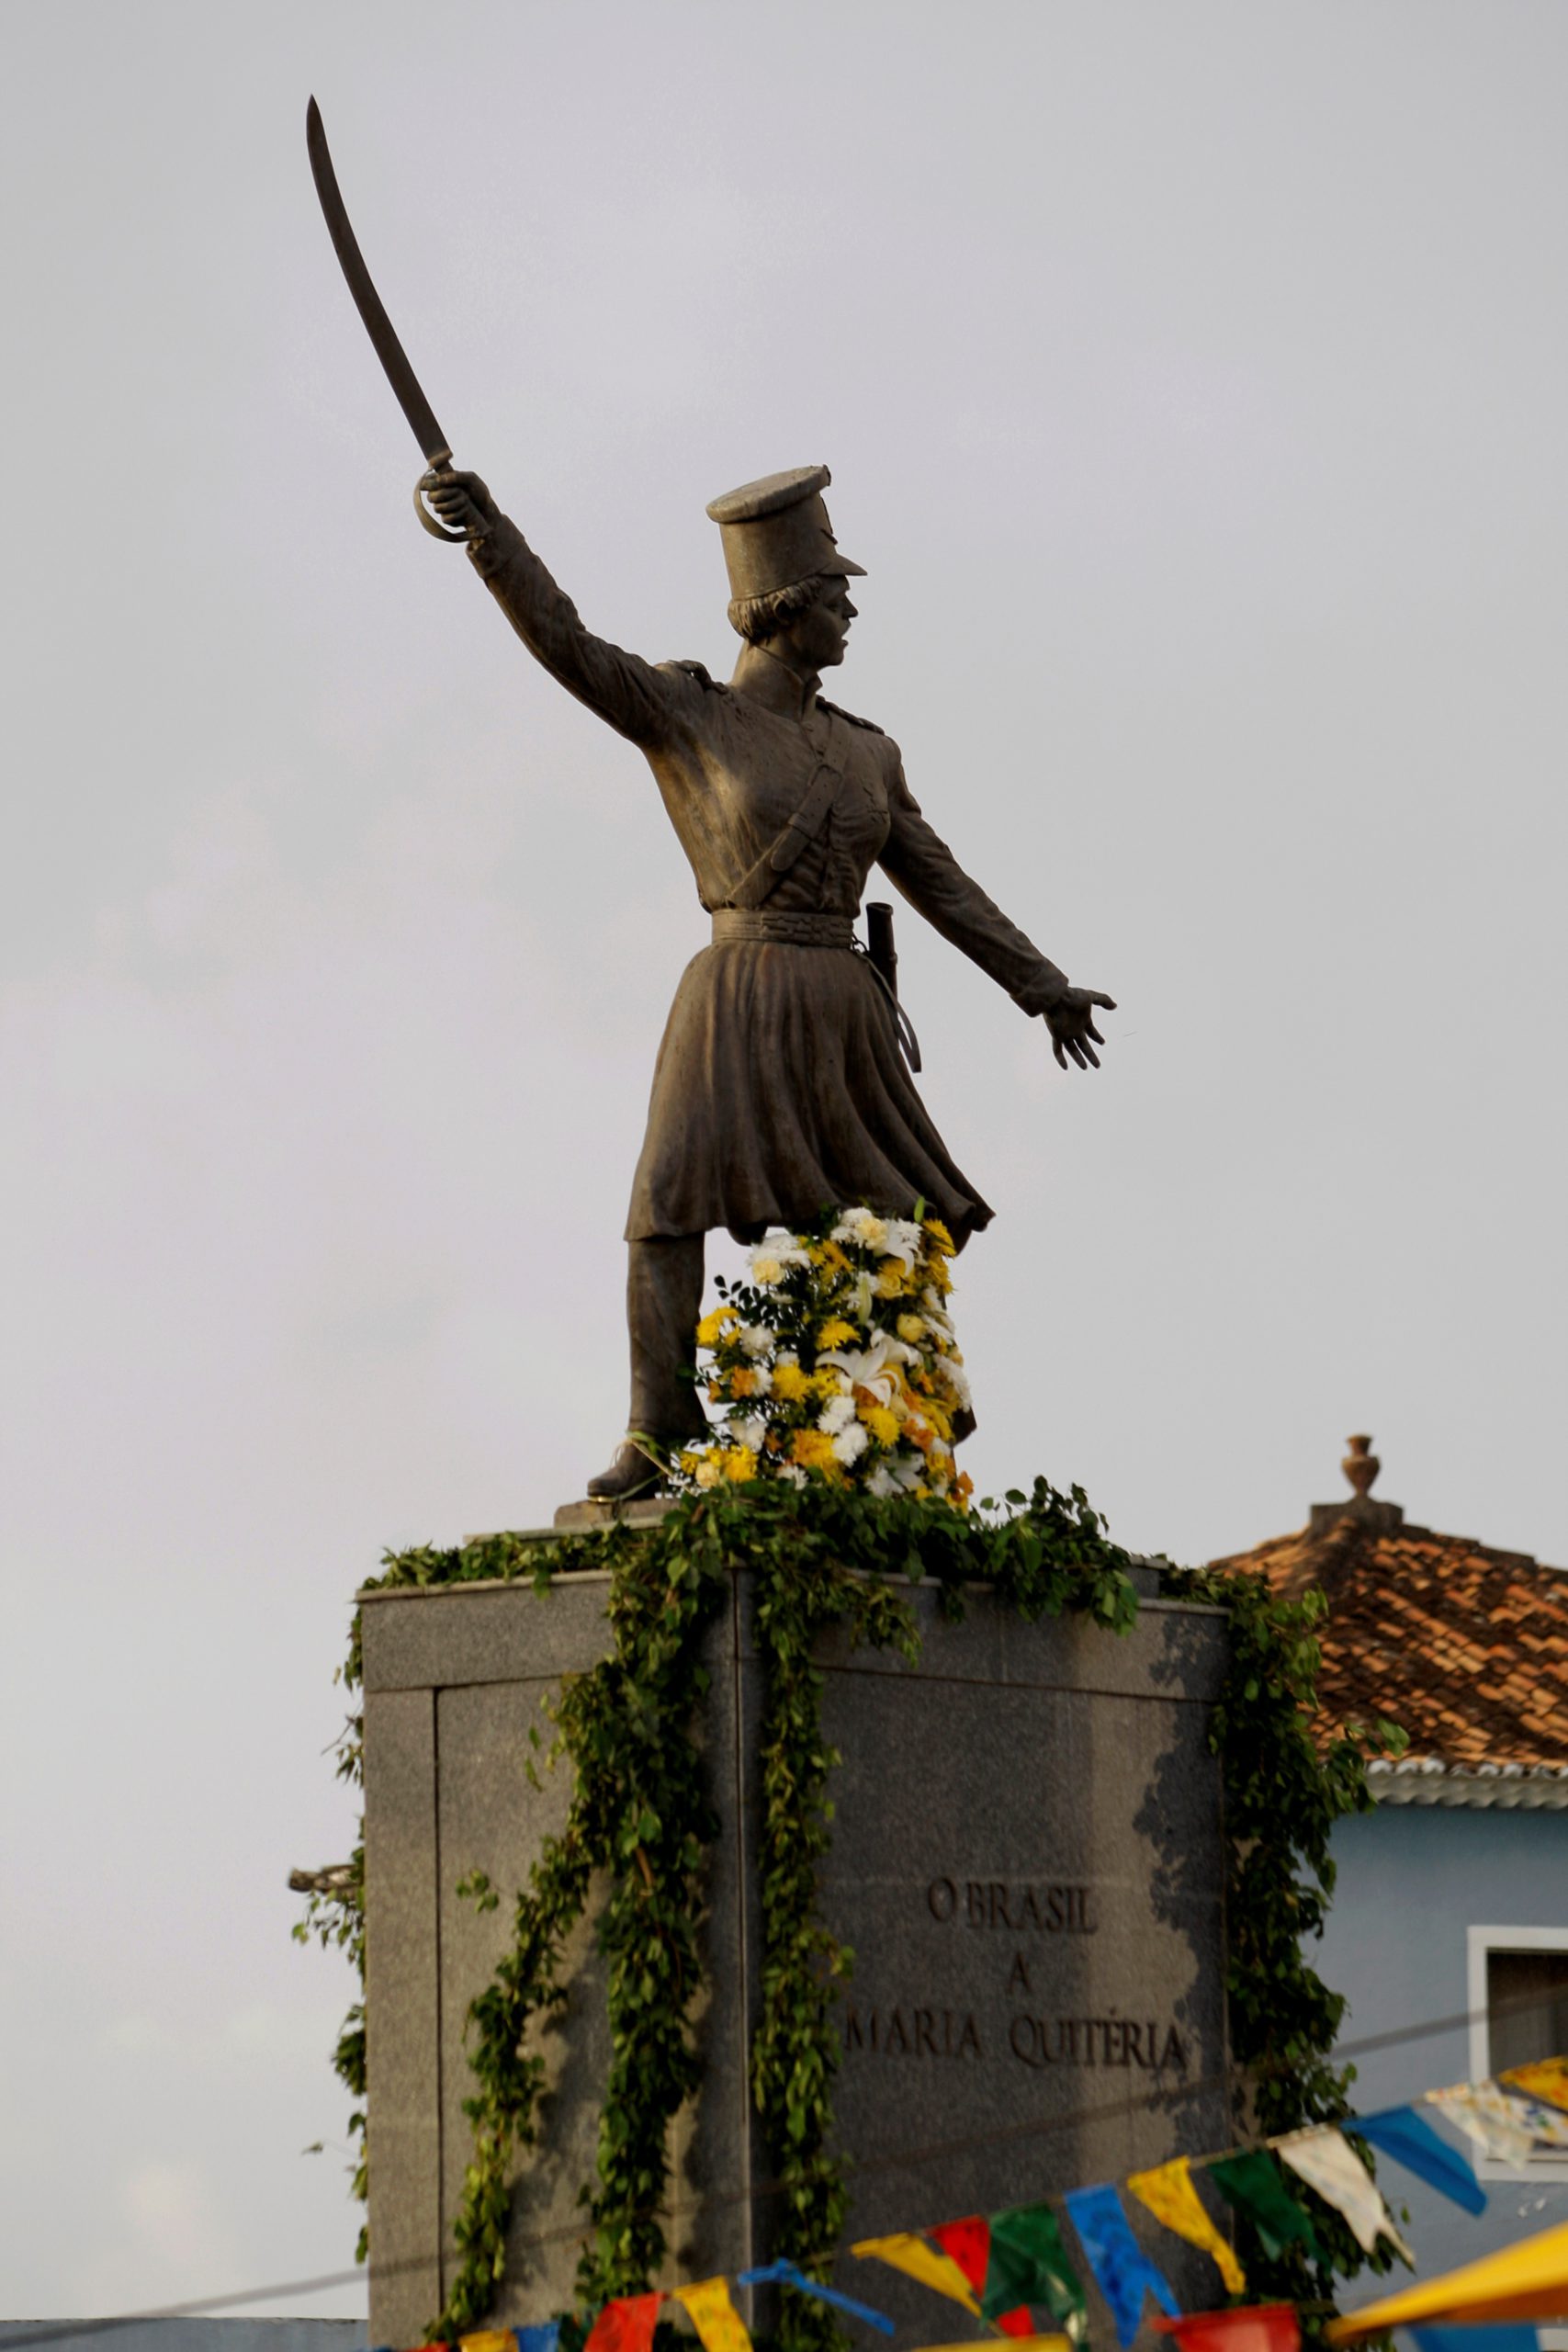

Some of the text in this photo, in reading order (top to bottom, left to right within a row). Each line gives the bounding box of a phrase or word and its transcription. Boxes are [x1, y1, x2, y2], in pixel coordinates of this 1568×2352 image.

[966, 1882, 1099, 1934] BRASIL
[1006, 1951, 1034, 1994] A
[844, 2004, 983, 2058] MARIA
